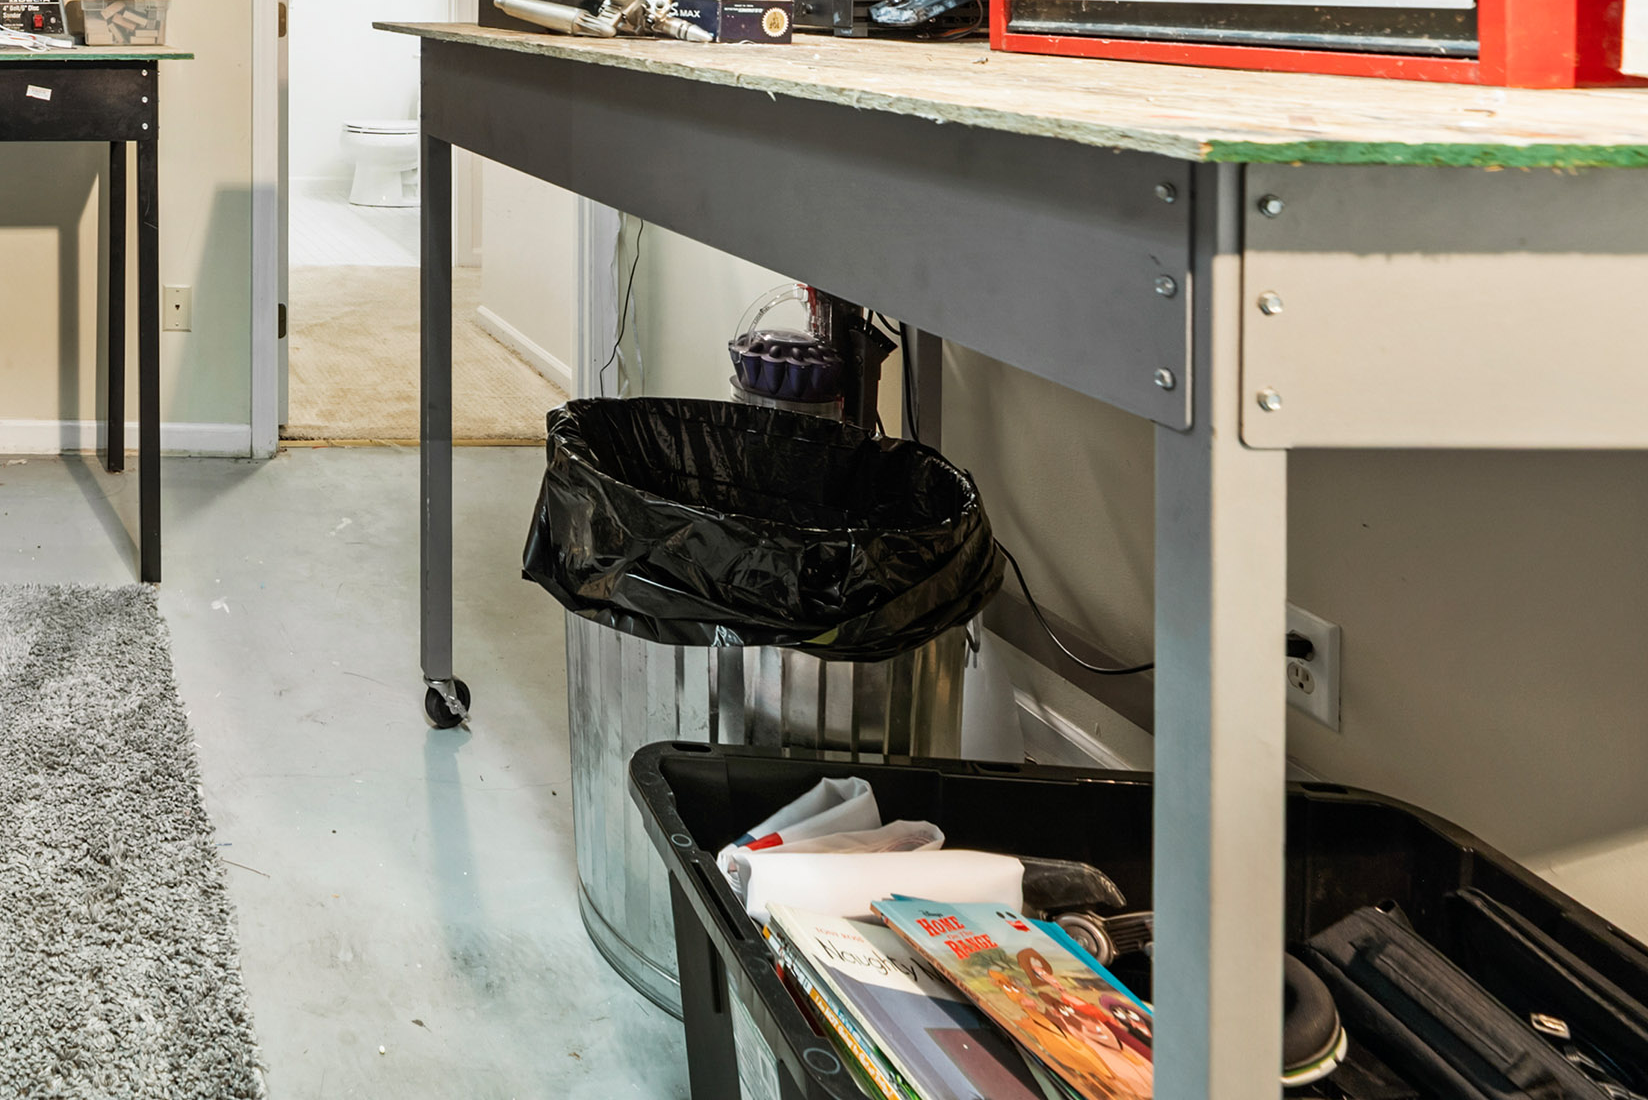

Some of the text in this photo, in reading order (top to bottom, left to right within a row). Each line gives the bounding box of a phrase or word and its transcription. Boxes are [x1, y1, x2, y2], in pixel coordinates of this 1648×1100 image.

[679, 9, 701, 18] MAX
[915, 915, 965, 937] HOME
[944, 933, 999, 960] RANGE
[815, 936, 919, 983] Naughty
